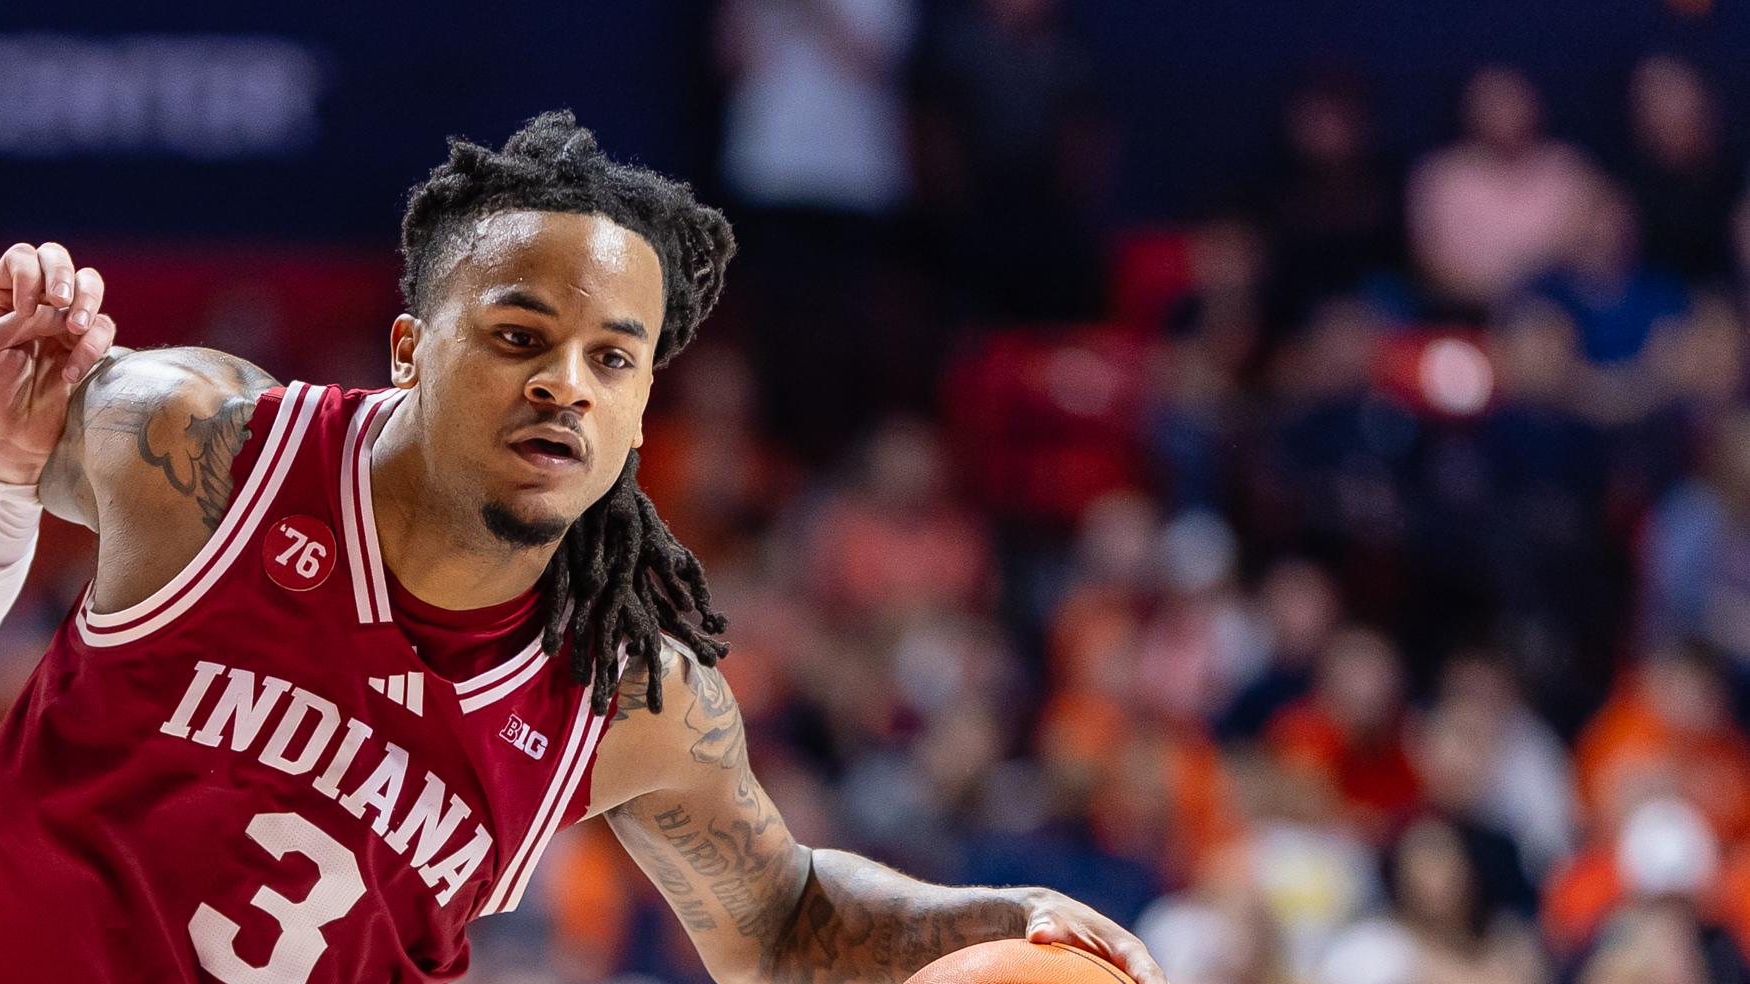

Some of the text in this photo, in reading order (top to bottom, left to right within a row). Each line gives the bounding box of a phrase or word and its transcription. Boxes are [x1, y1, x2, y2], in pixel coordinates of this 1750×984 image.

[275, 524, 327, 579] '76
[159, 659, 494, 908] INDIANA
[653, 803, 729, 877] HARD
